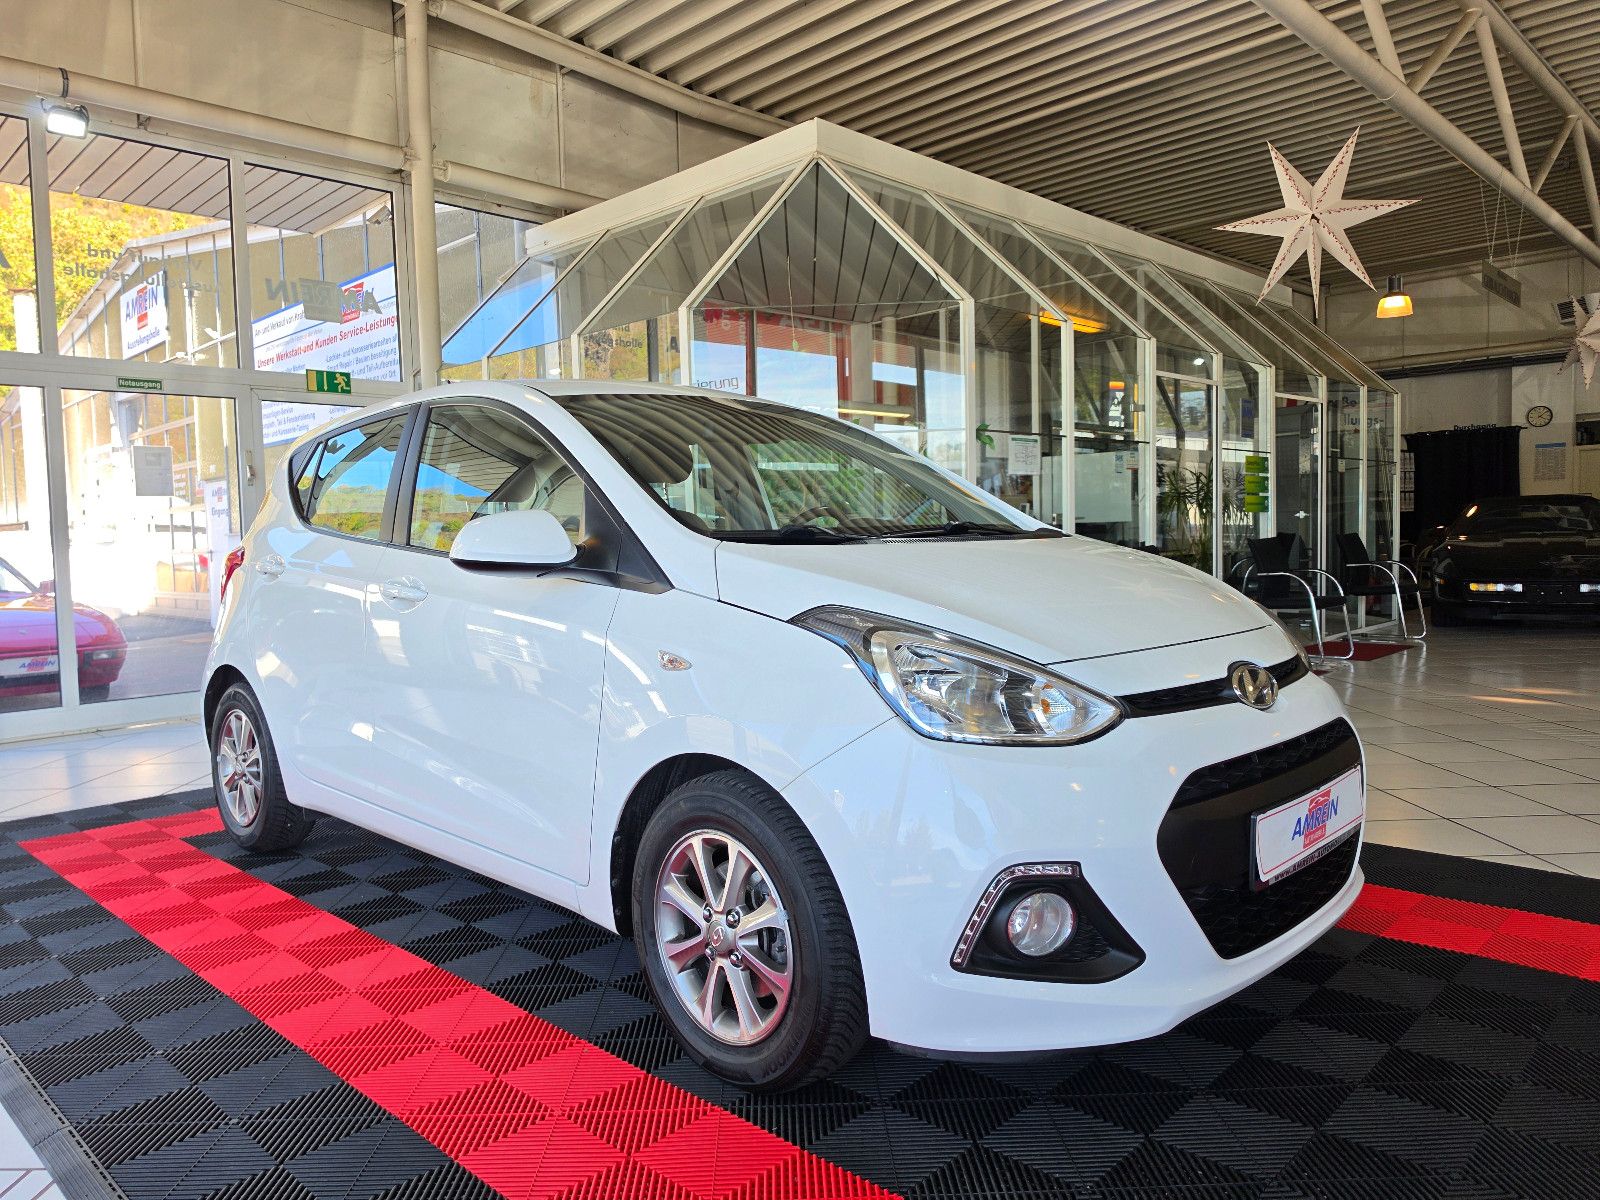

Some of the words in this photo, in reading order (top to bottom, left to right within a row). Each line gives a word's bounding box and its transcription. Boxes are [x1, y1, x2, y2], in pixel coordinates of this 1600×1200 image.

[125, 286, 159, 321] AMREIN
[257, 356, 275, 368] Unsere
[315, 334, 338, 350] Kunden
[119, 379, 162, 390] Notausgang
[1291, 796, 1339, 841] AMREIN
